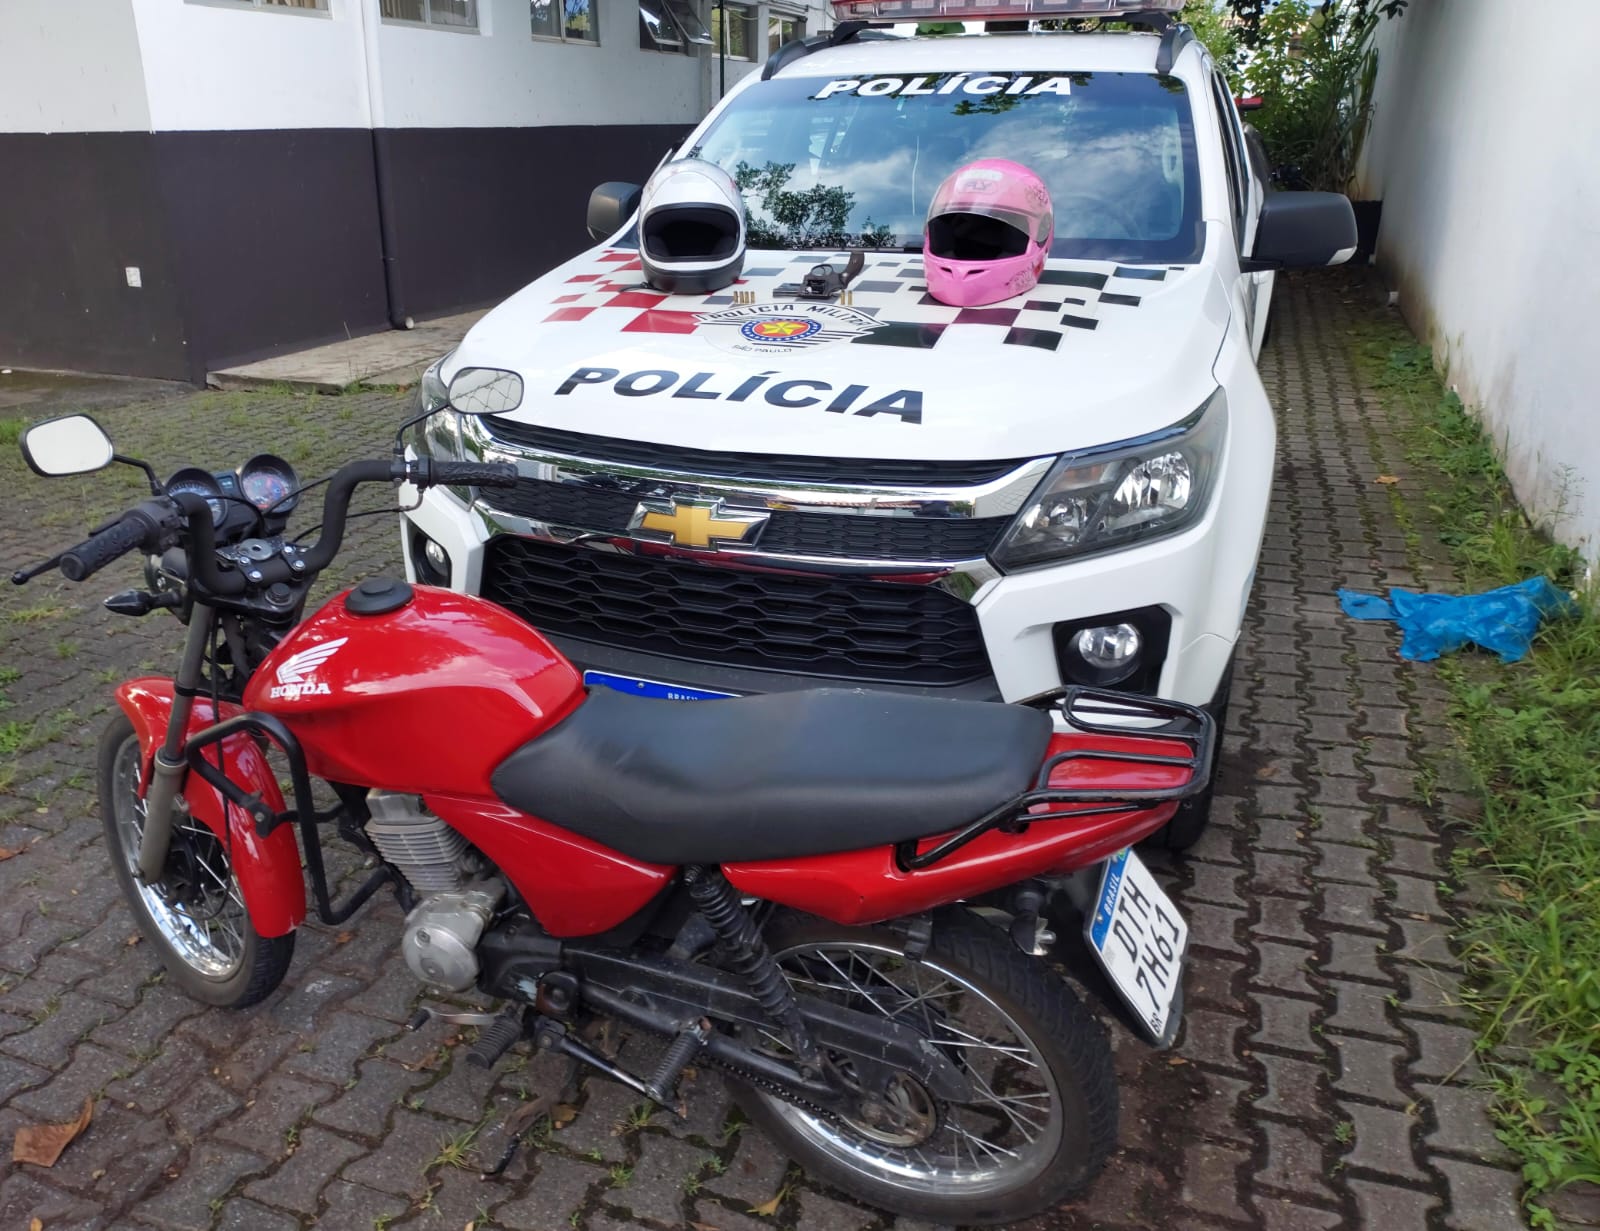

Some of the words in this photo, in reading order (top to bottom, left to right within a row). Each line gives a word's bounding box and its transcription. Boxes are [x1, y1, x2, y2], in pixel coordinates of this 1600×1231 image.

[814, 72, 1072, 99] POLÍCIA
[554, 367, 924, 425] POLÍCIA
[270, 682, 332, 699] HONDA
[1103, 873, 1120, 916] BRASIL
[1113, 875, 1151, 963] DTH
[1136, 904, 1180, 1012] 7H61
